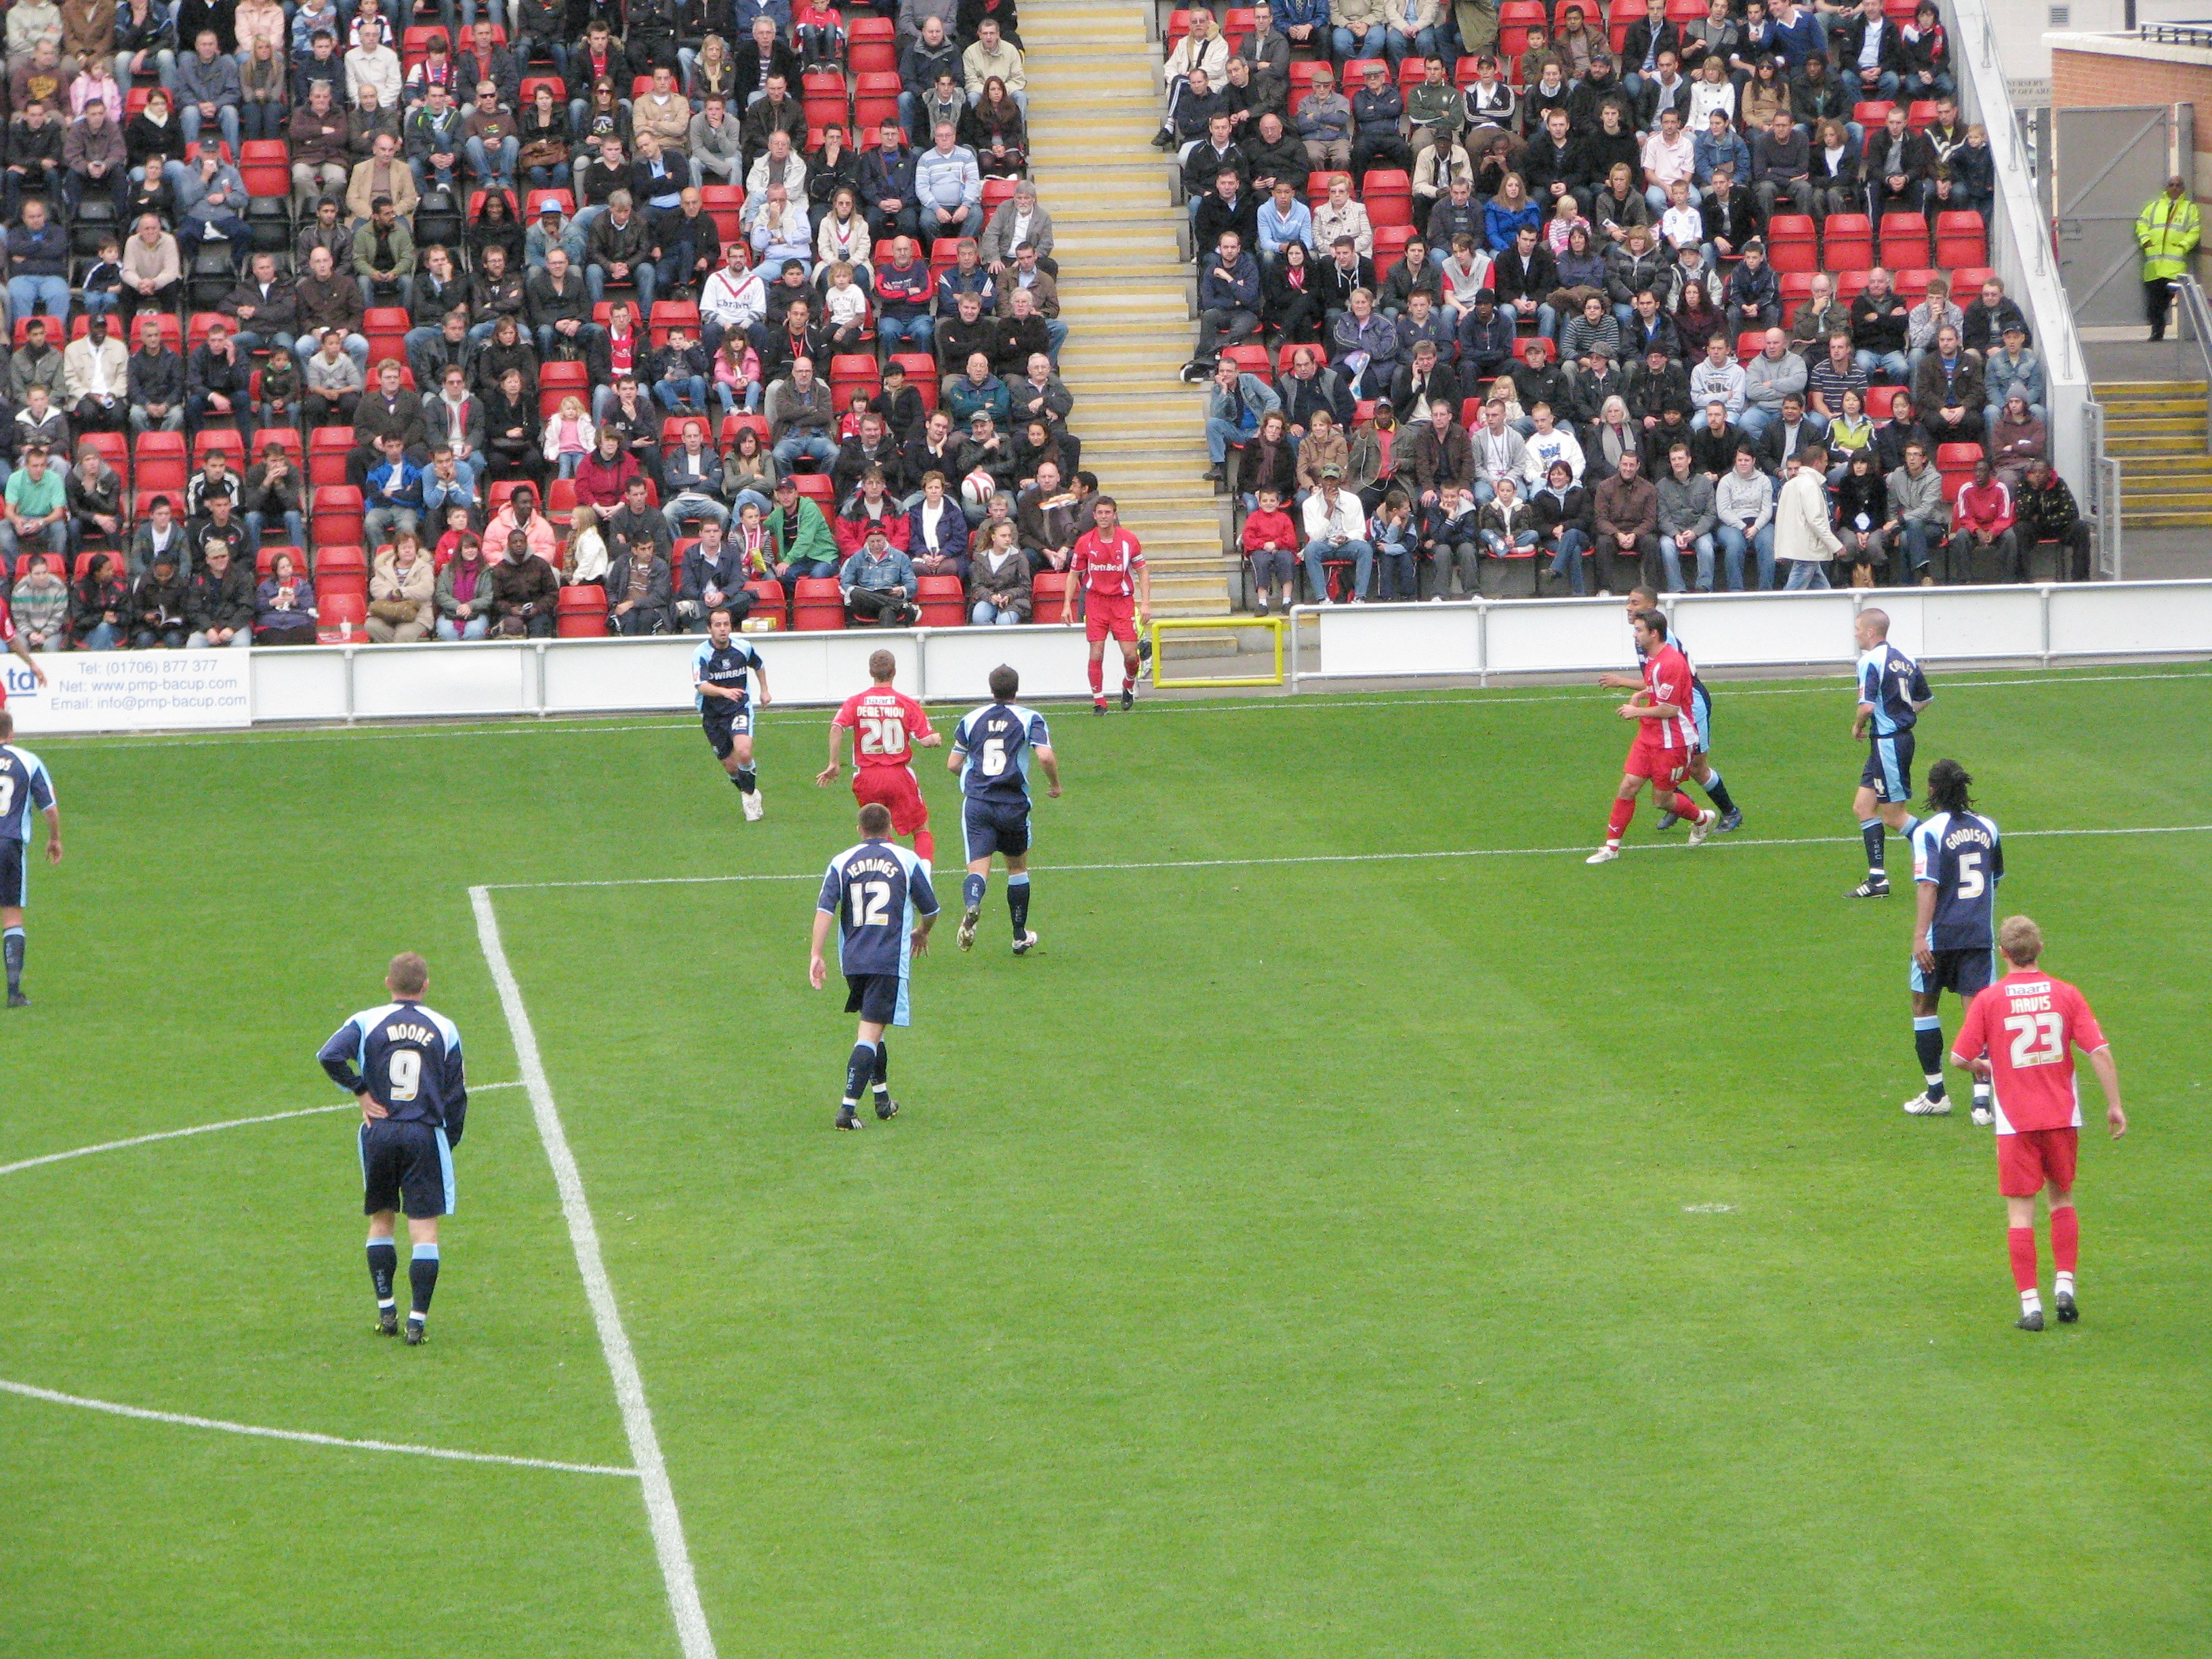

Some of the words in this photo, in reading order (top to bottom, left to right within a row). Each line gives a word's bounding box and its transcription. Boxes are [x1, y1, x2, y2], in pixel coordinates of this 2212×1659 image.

[1671, 216, 1677, 224] 9
[78, 662, 100, 674] Tel:
[106, 660, 158, 676] (01706)
[163, 660, 186, 672] 877
[192, 659, 219, 672] 377
[714, 665, 747, 680] WIRRAL
[60, 680, 87, 693] Net:
[91, 678, 237, 693] www.pmp-bacup.com
[52, 697, 93, 710] Email:
[98, 695, 247, 710] info@pmp-bacup.com
[857, 705, 905, 718] DEMETRIOU
[987, 720, 1008, 732] KAY
[859, 718, 905, 754] 20
[983, 739, 1006, 776] 6
[1946, 827, 1991, 850] GOODISON
[846, 857, 899, 878] JENNINGS
[1958, 852, 1984, 899] 5
[849, 881, 890, 927] 12
[2006, 983, 2050, 995] haart
[2011, 996, 2051, 1014] JARVIS
[386, 1023, 435, 1047] MOORE
[2004, 1012, 2064, 1069] 23
[389, 1049, 422, 1102] 9
